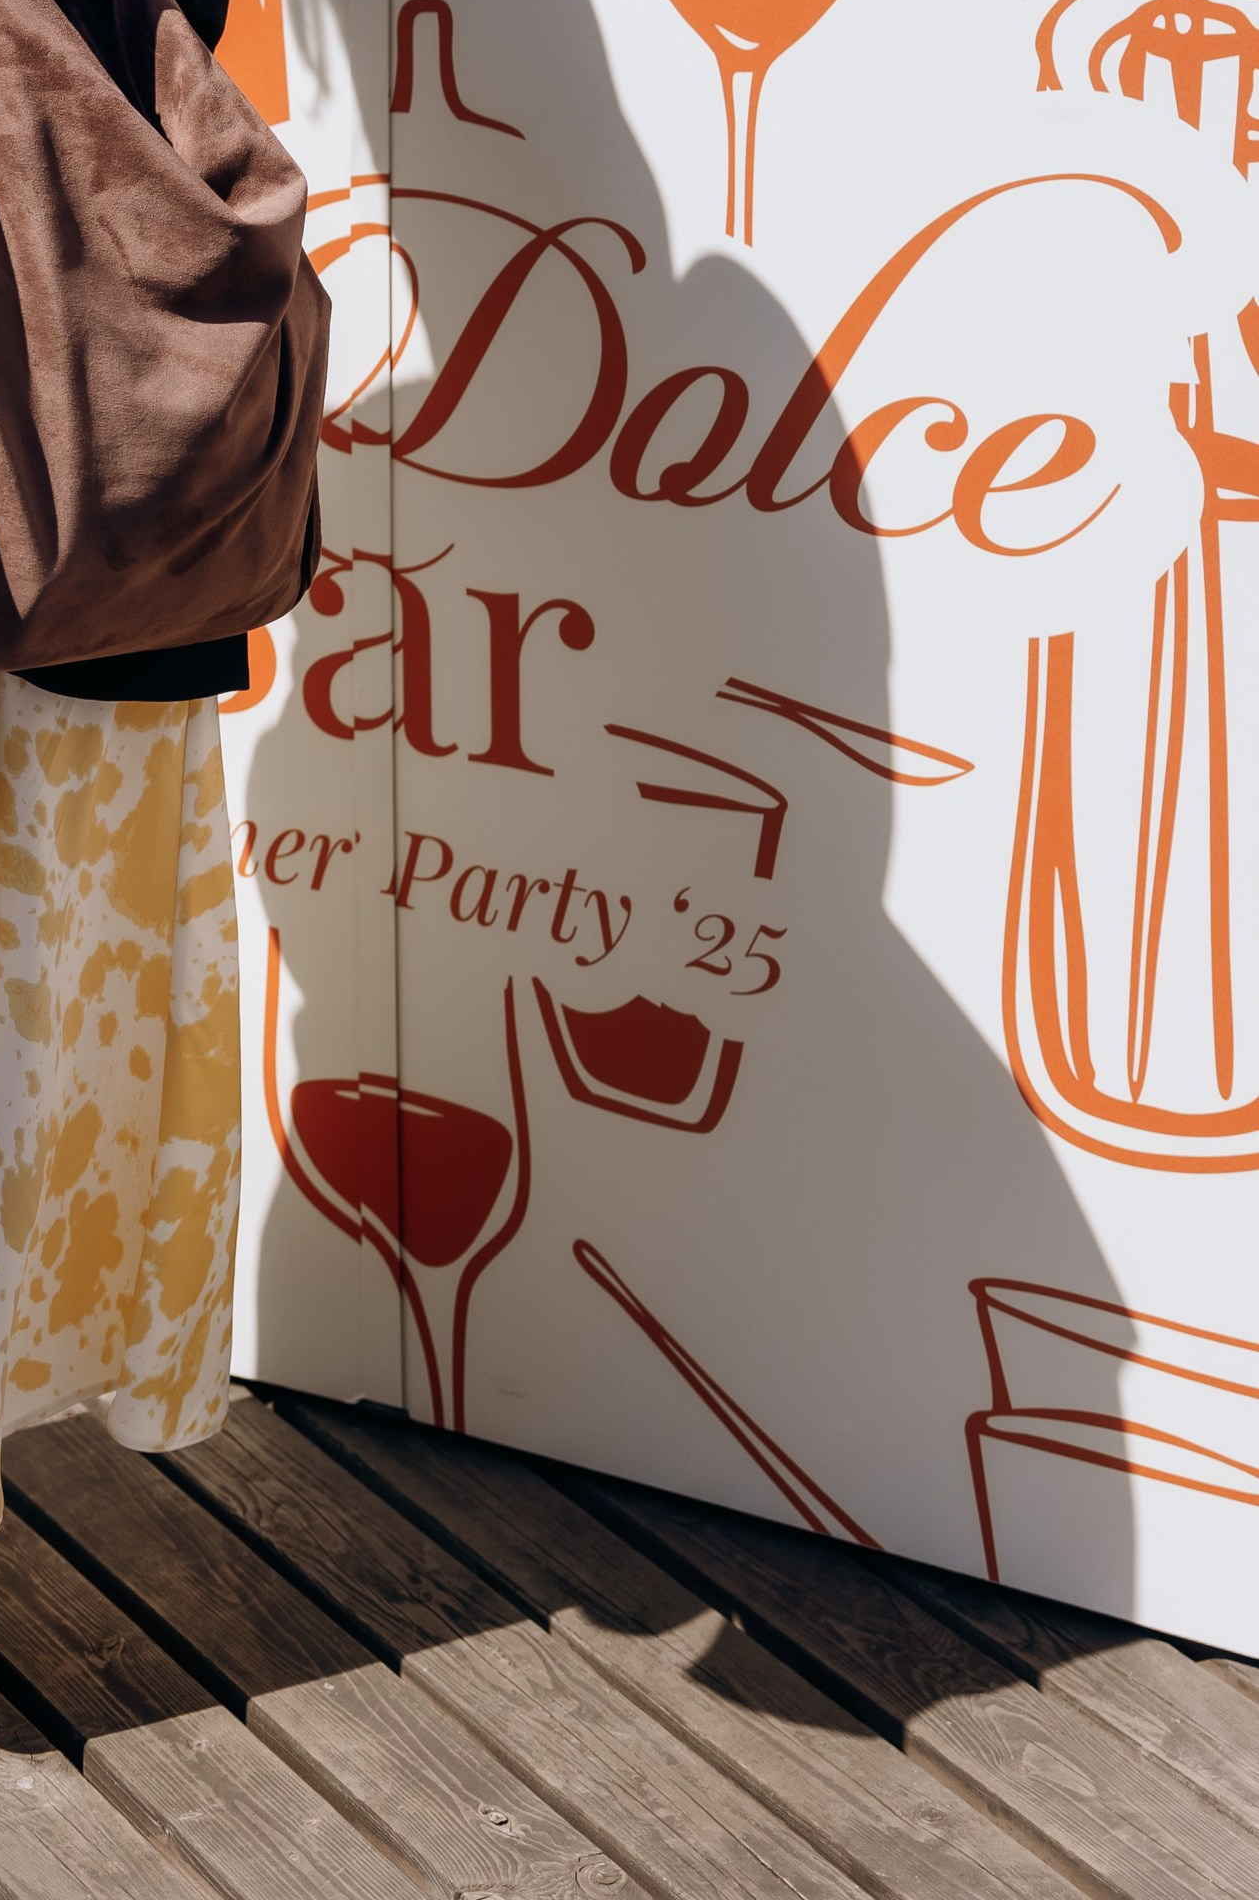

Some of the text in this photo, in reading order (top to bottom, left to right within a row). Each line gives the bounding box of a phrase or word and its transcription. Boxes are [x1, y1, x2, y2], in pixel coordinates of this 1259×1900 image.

[300, 173, 1182, 557] Dolce
[216, 542, 595, 778] ar
[378, 829, 633, 970] Party
